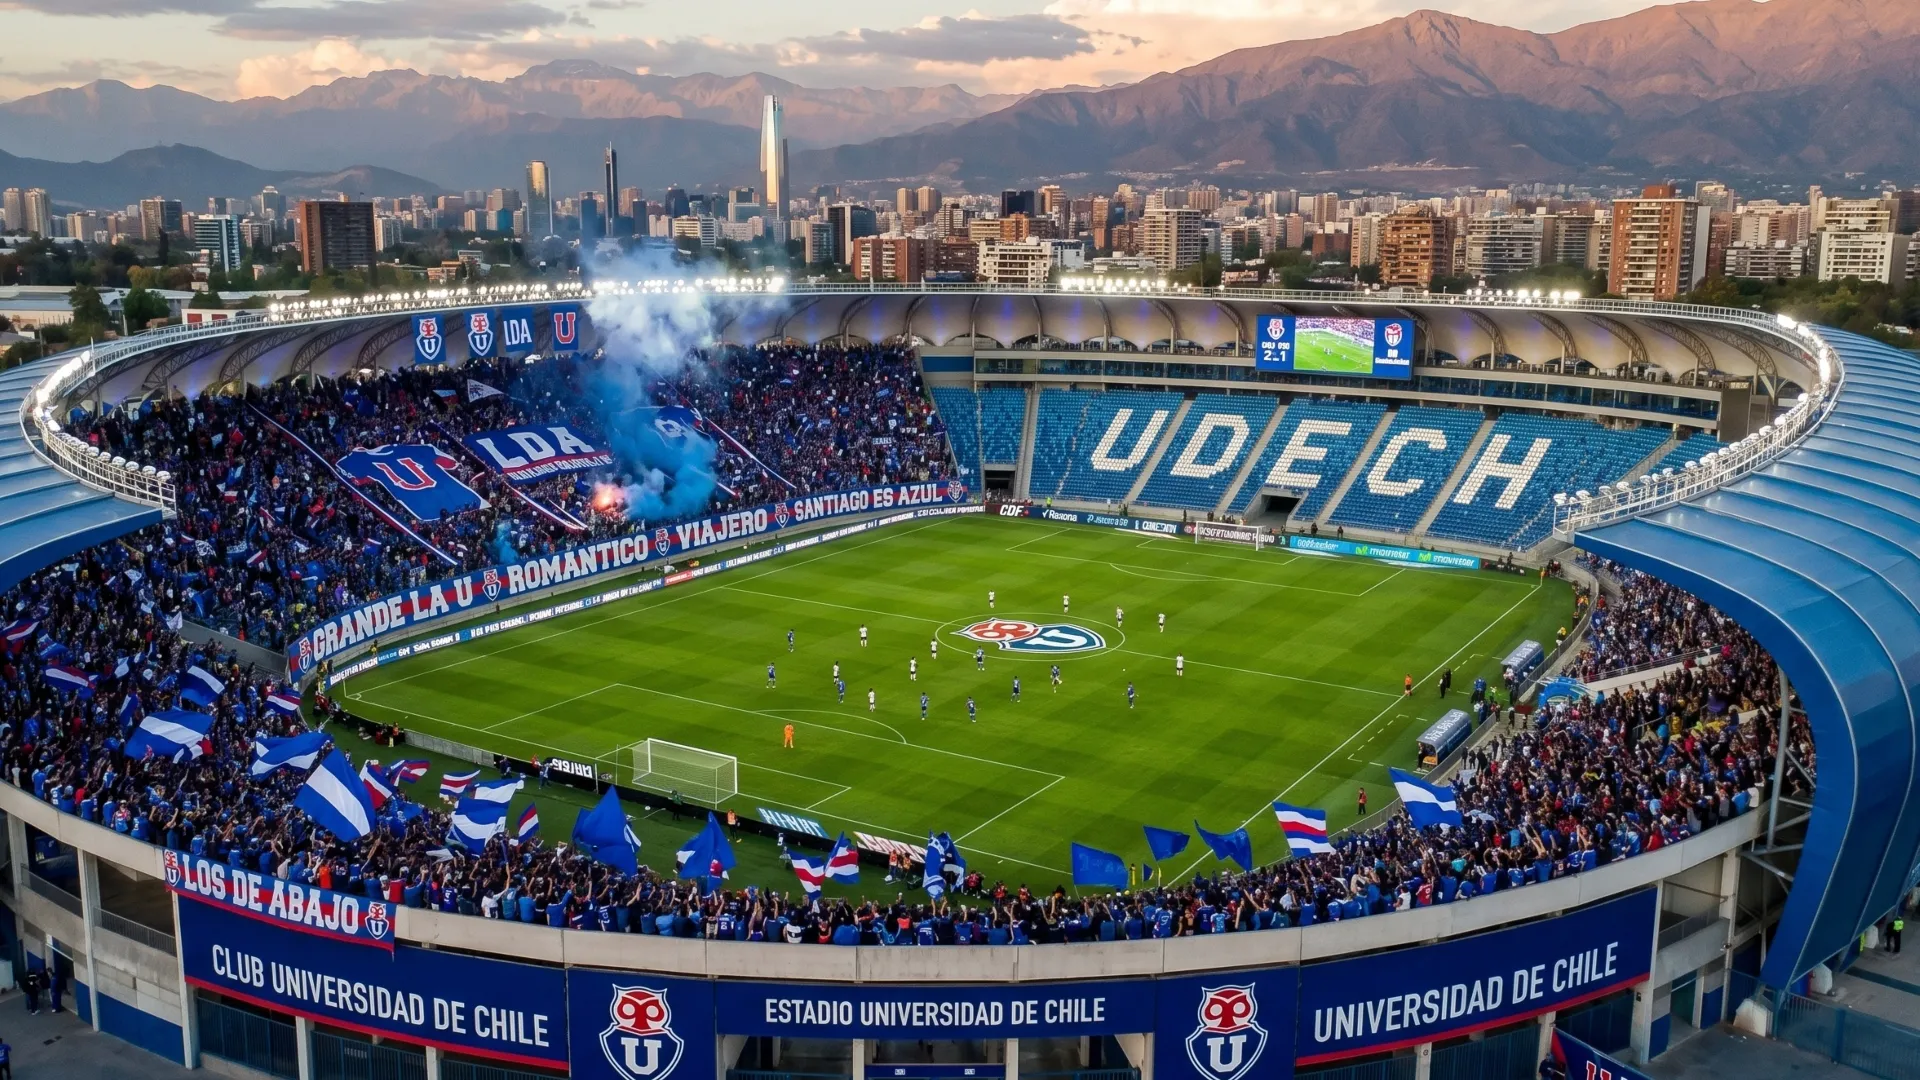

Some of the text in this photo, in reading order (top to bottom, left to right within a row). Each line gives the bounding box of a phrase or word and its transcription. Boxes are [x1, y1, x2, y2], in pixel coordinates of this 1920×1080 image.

[503, 318, 532, 346] LDA
[553, 312, 576, 344] U
[475, 426, 597, 469] LDA
[373, 457, 437, 491] U
[313, 595, 405, 662] GRANDE
[410, 585, 450, 622] LA
[453, 577, 474, 607] U
[676, 508, 768, 550] VIAJERO
[794, 489, 869, 521] SANTIAGO
[873, 487, 894, 509] ES
[898, 483, 943, 507] AZUL
[182, 853, 226, 900] LOS
[231, 869, 263, 912] DE
[268, 880, 360, 935] ABAJO
[212, 944, 550, 1048] CLUB UNIVERSIDAD DE CHILE
[765, 997, 1106, 1026] ESTADIO UNIVERSIDAD DE CHILE
[1314, 941, 1619, 1043] UNIVERSIDAD DE CHILE
[620, 1037, 662, 1076] U
[1206, 1034, 1247, 1073] U
